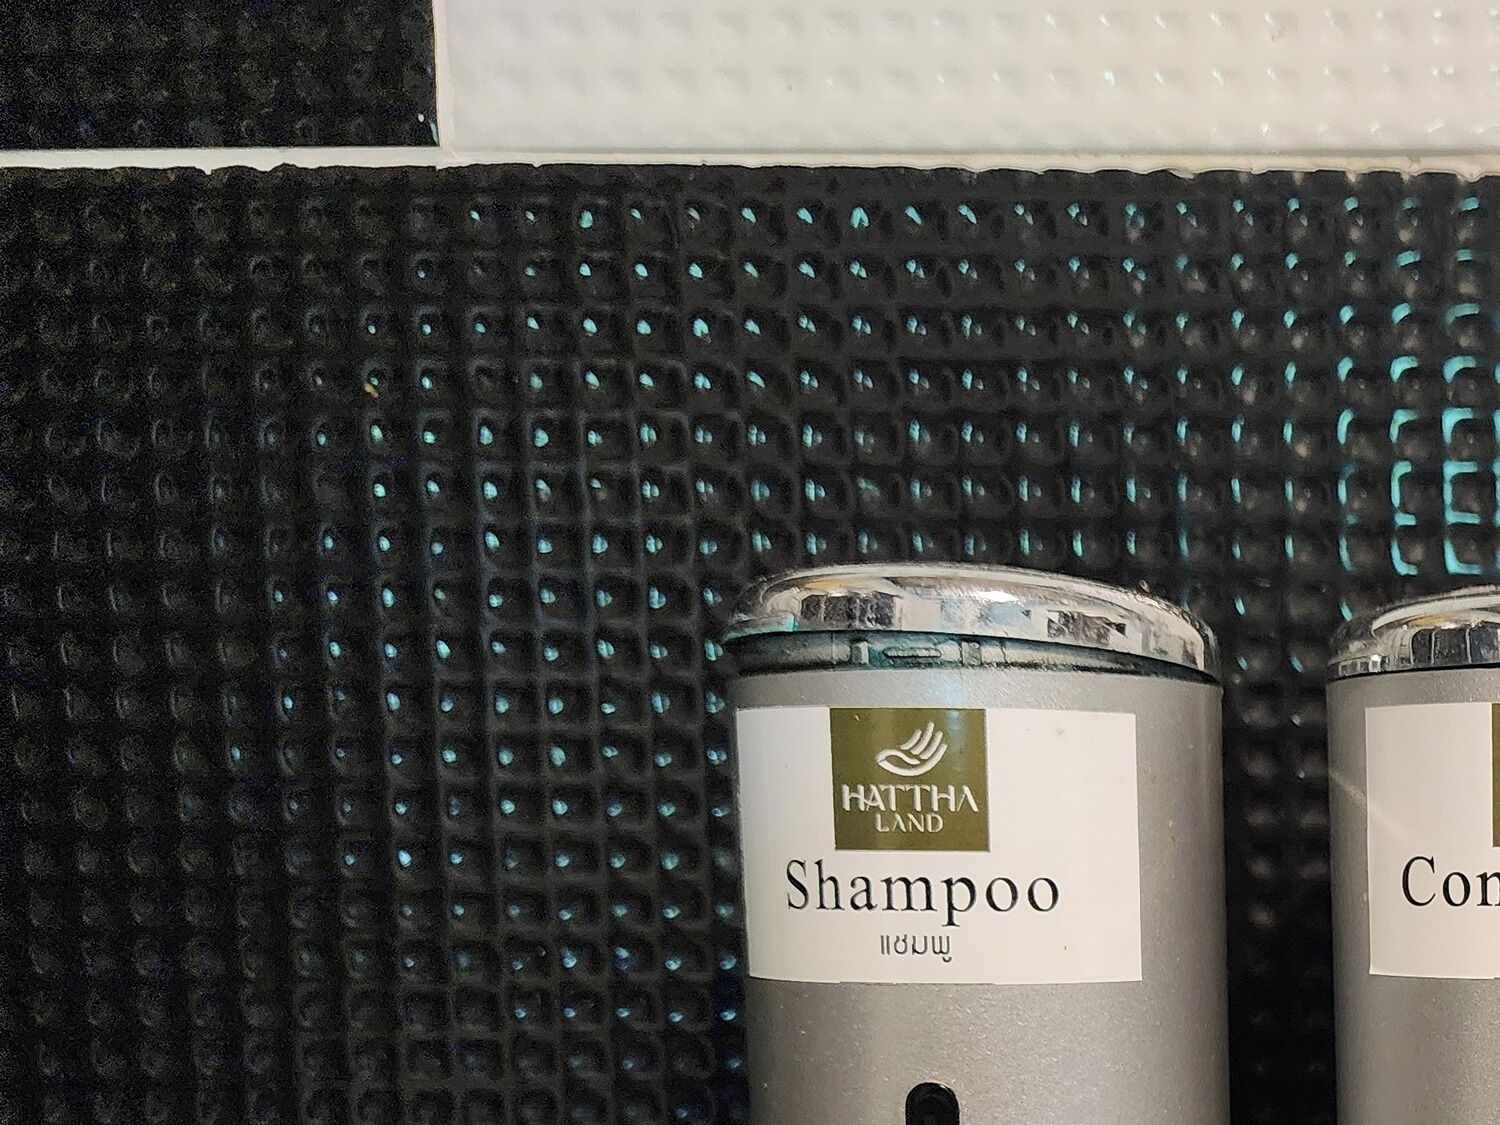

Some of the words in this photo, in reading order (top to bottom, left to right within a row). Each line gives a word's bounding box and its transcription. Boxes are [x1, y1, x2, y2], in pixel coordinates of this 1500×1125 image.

[841, 783, 980, 814] HATTHA
[874, 813, 944, 833] LAND
[786, 857, 1060, 928] Shampoo
[880, 933, 953, 963] แชมพู
